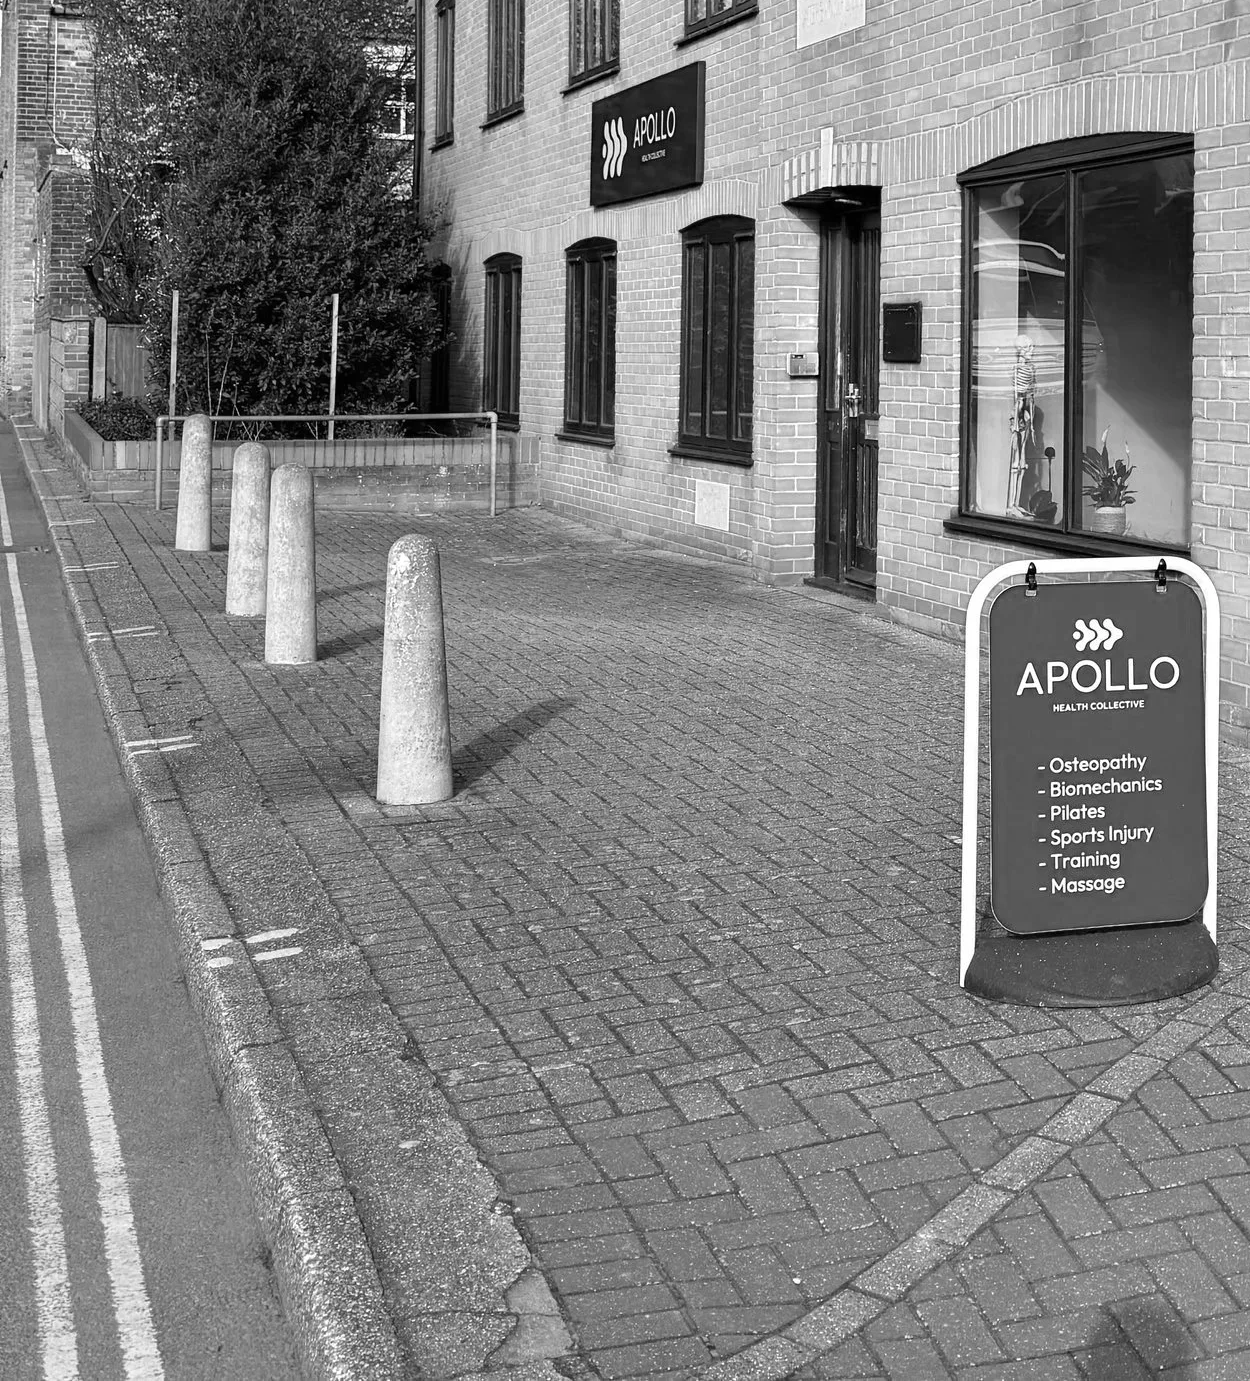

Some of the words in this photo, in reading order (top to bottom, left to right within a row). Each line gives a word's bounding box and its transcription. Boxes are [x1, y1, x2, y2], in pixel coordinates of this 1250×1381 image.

[632, 106, 676, 149] APOLLO
[1016, 656, 1180, 696] APOLLO
[1052, 702, 1089, 713] HEALTH
[1090, 699, 1145, 711] COLLECTIVE
[1049, 752, 1147, 775] Osteopathy
[1050, 776, 1163, 798] Biomechanics
[1050, 804, 1106, 822] Pilates
[1050, 827, 1105, 849] Sports
[1108, 824, 1155, 845] Injury
[1050, 850, 1121, 870] Training
[1051, 876, 1126, 894] Massage
